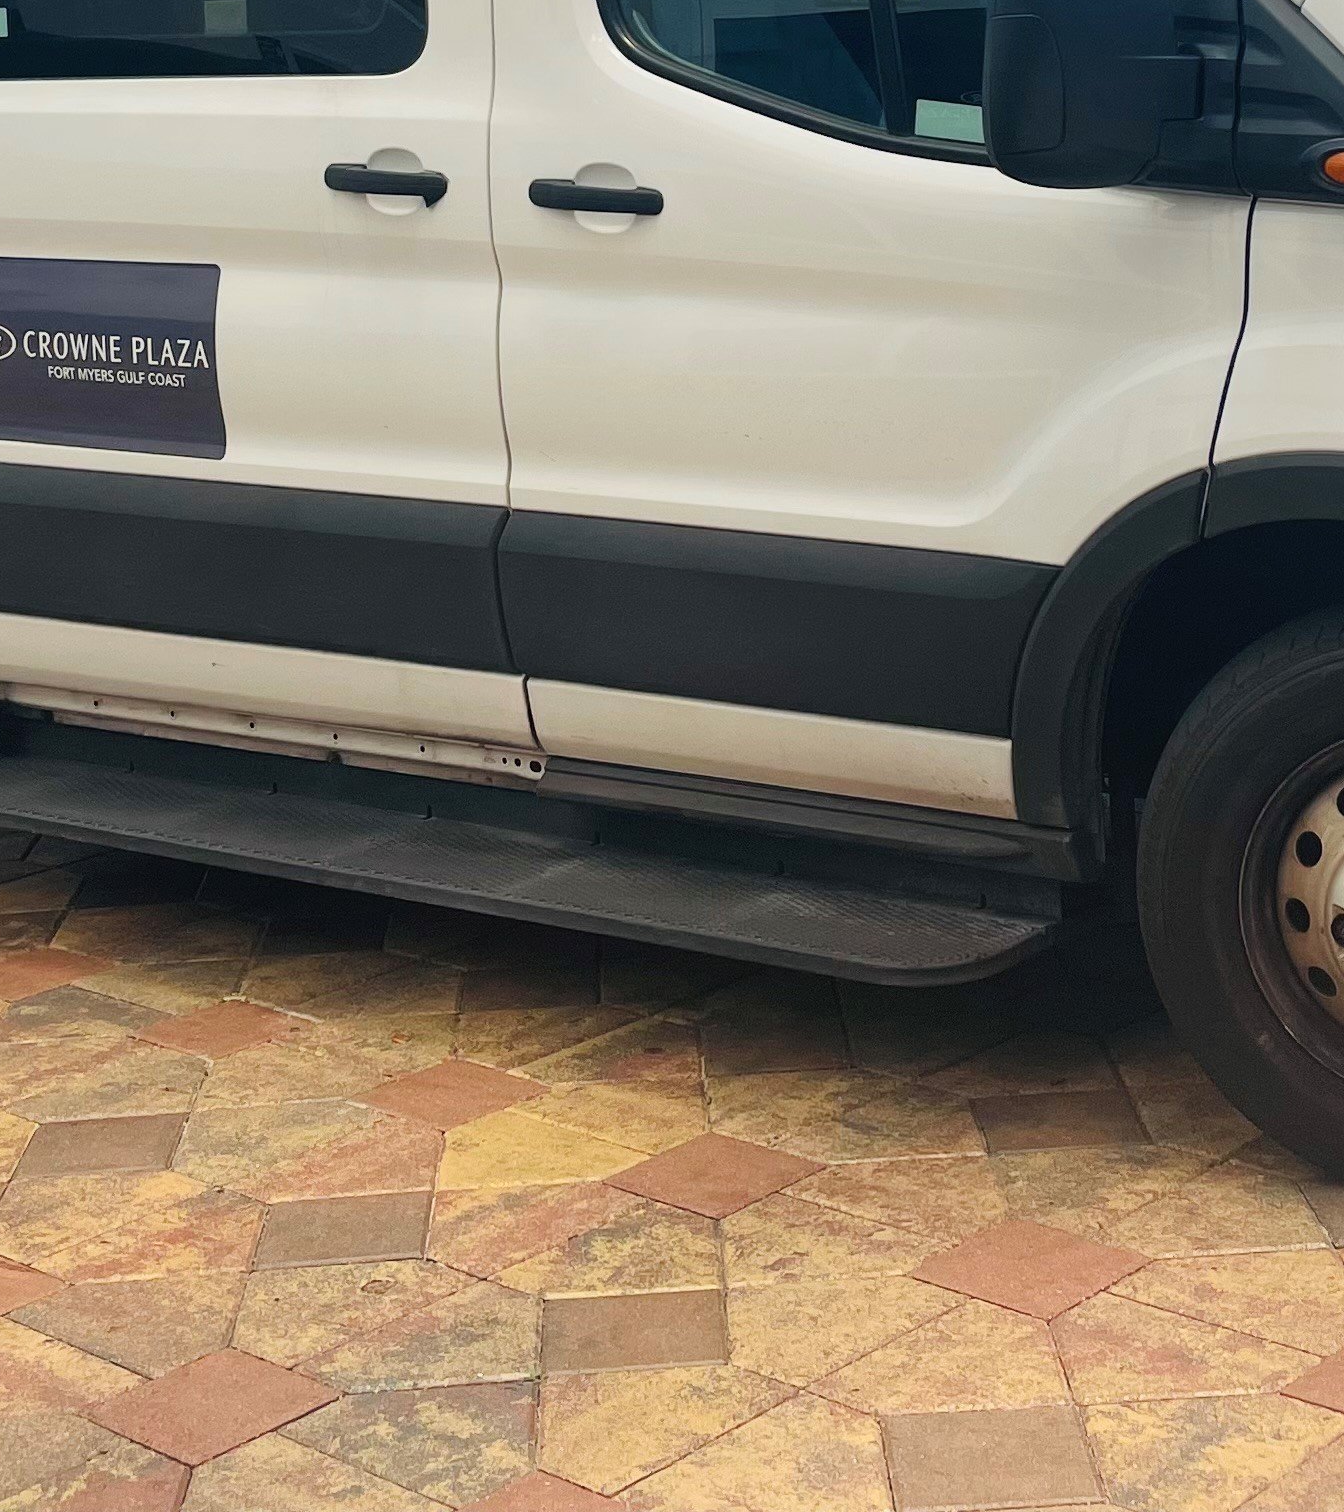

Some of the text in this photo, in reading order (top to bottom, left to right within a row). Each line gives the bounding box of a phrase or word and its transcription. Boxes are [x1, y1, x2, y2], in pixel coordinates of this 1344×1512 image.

[22, 330, 210, 369] CROWNE PLAZA
[48, 365, 186, 388] FORT MYERS GULF COAST
